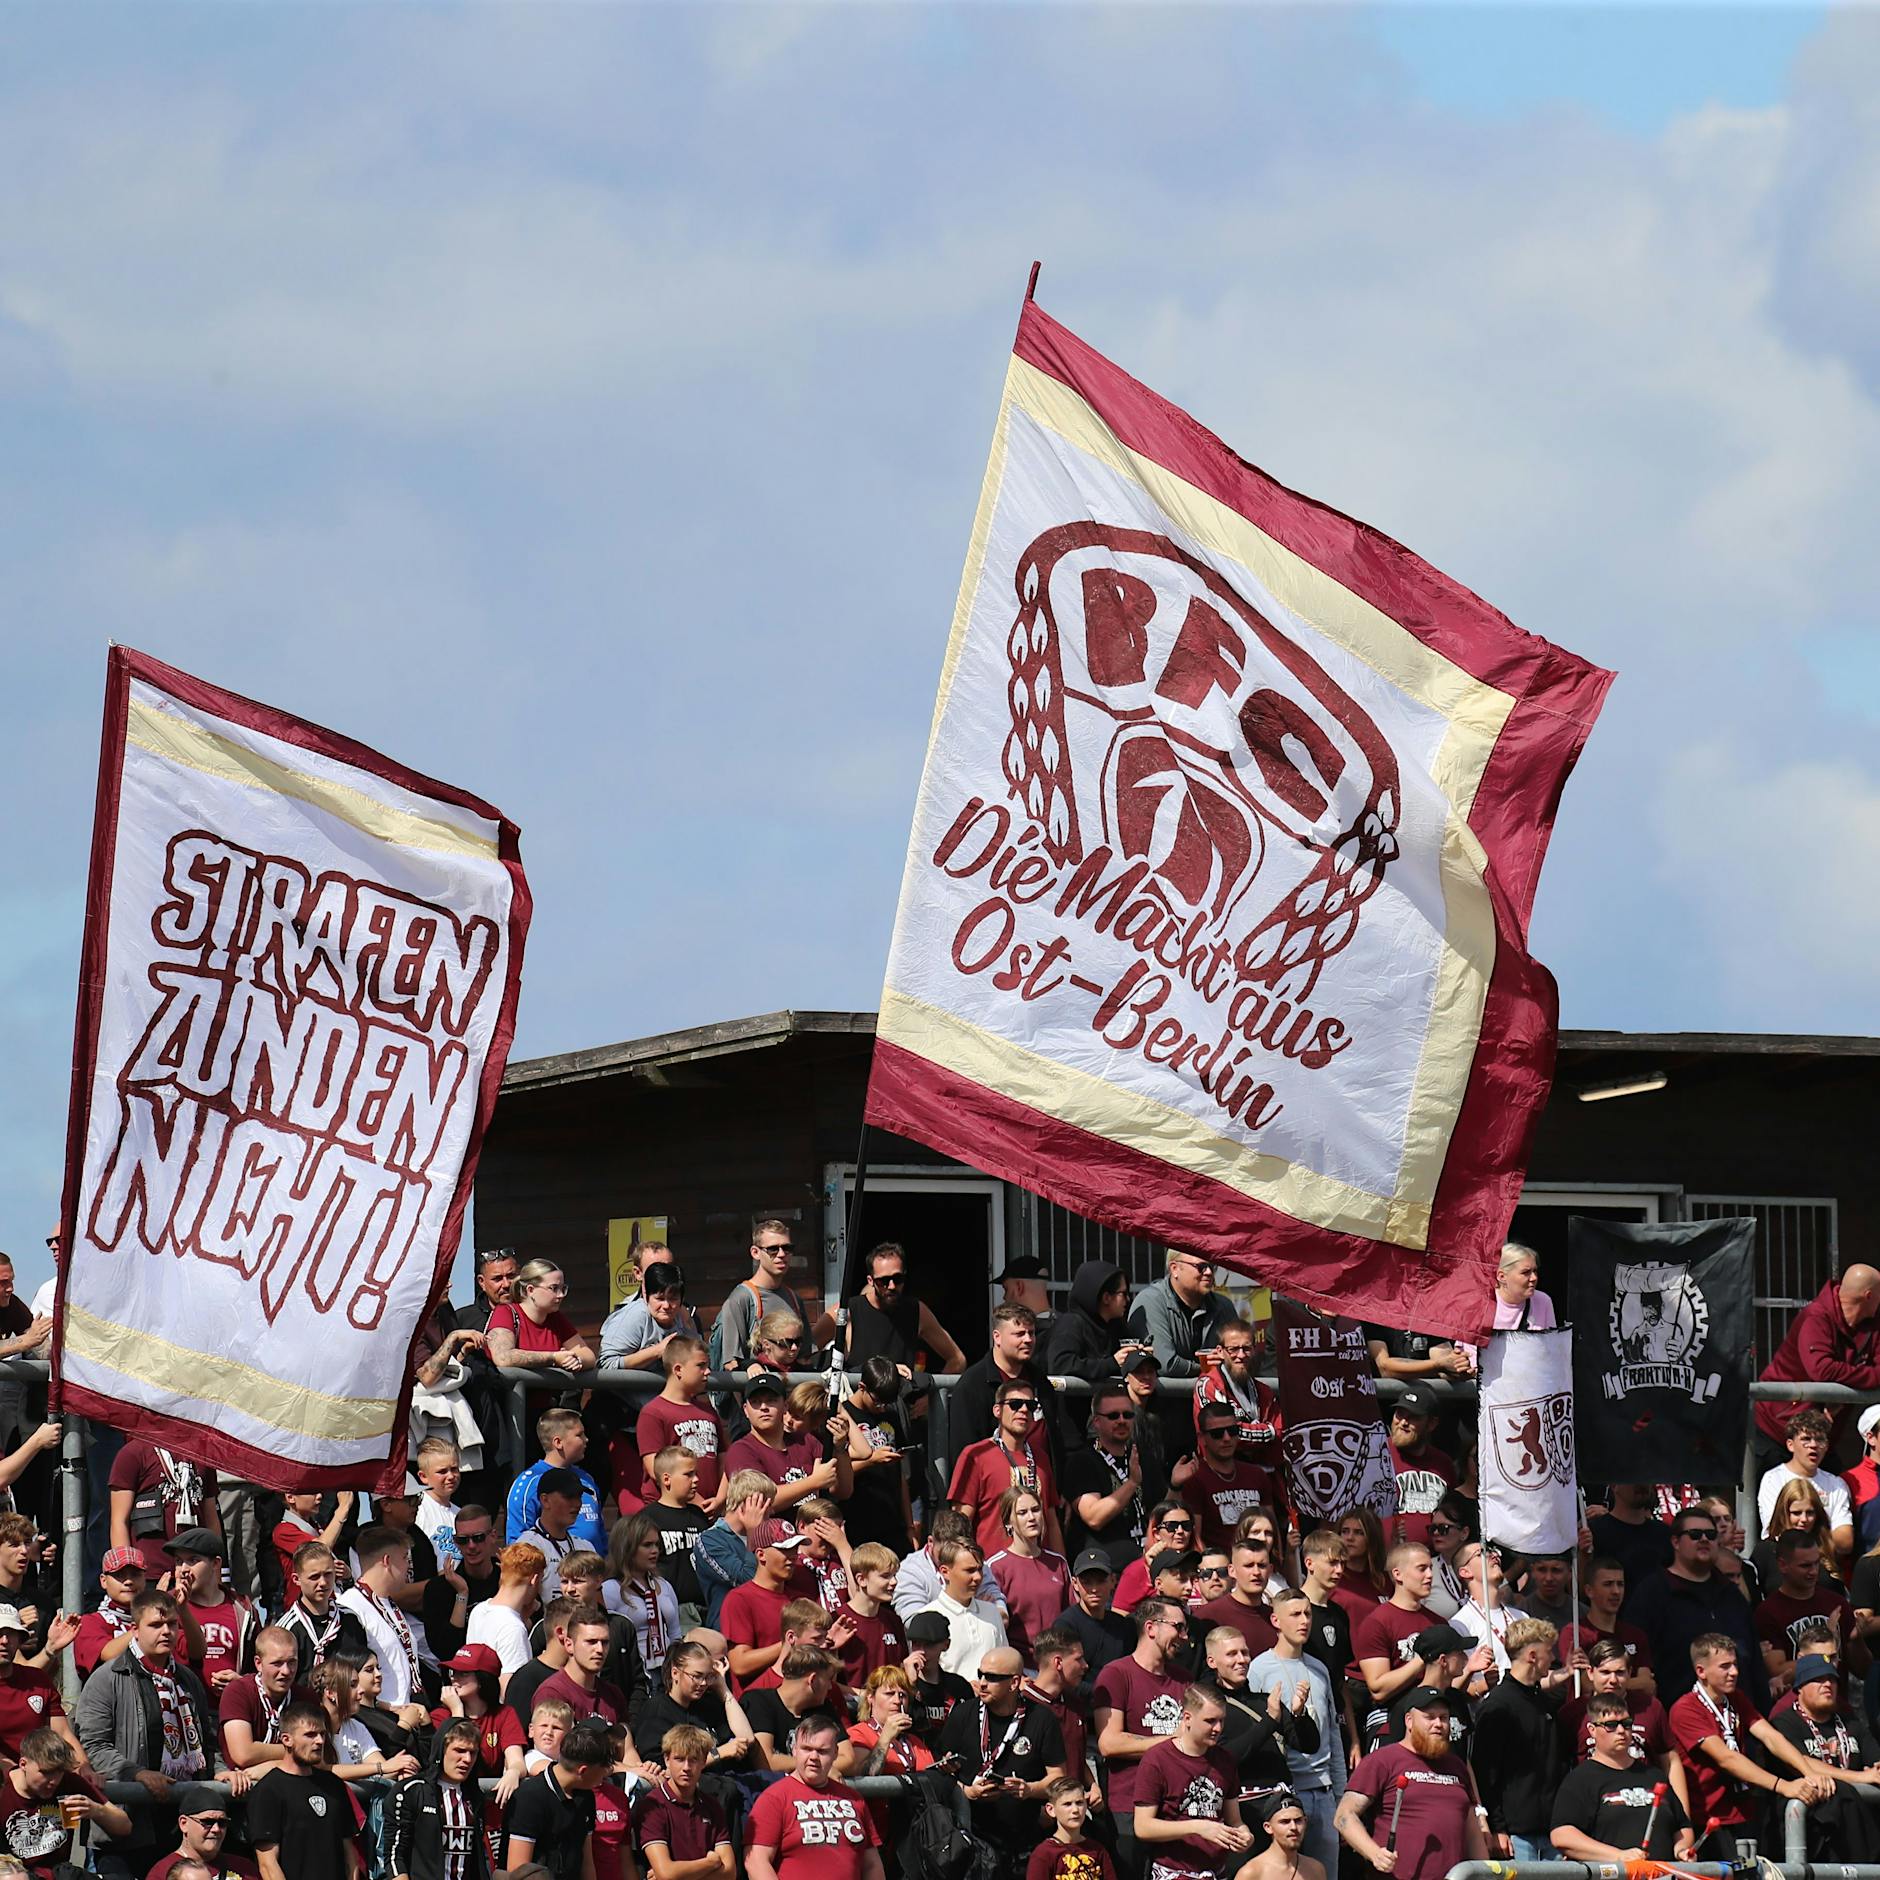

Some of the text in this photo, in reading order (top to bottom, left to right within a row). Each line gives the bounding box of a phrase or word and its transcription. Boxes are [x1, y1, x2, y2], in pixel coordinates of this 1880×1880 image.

[151, 829, 499, 1037] STRAFEN
[933, 797, 1352, 1069] Die Macht aus
[86, 1085, 432, 1330] NICHT!
[1288, 1327, 1320, 1349] FH
[1283, 1427, 1361, 1464] BFC
[661, 1531, 684, 1555] BFC
[200, 1622, 234, 1649] FC
[794, 1799, 856, 1821] MKS
[801, 1820, 864, 1844] BFC
